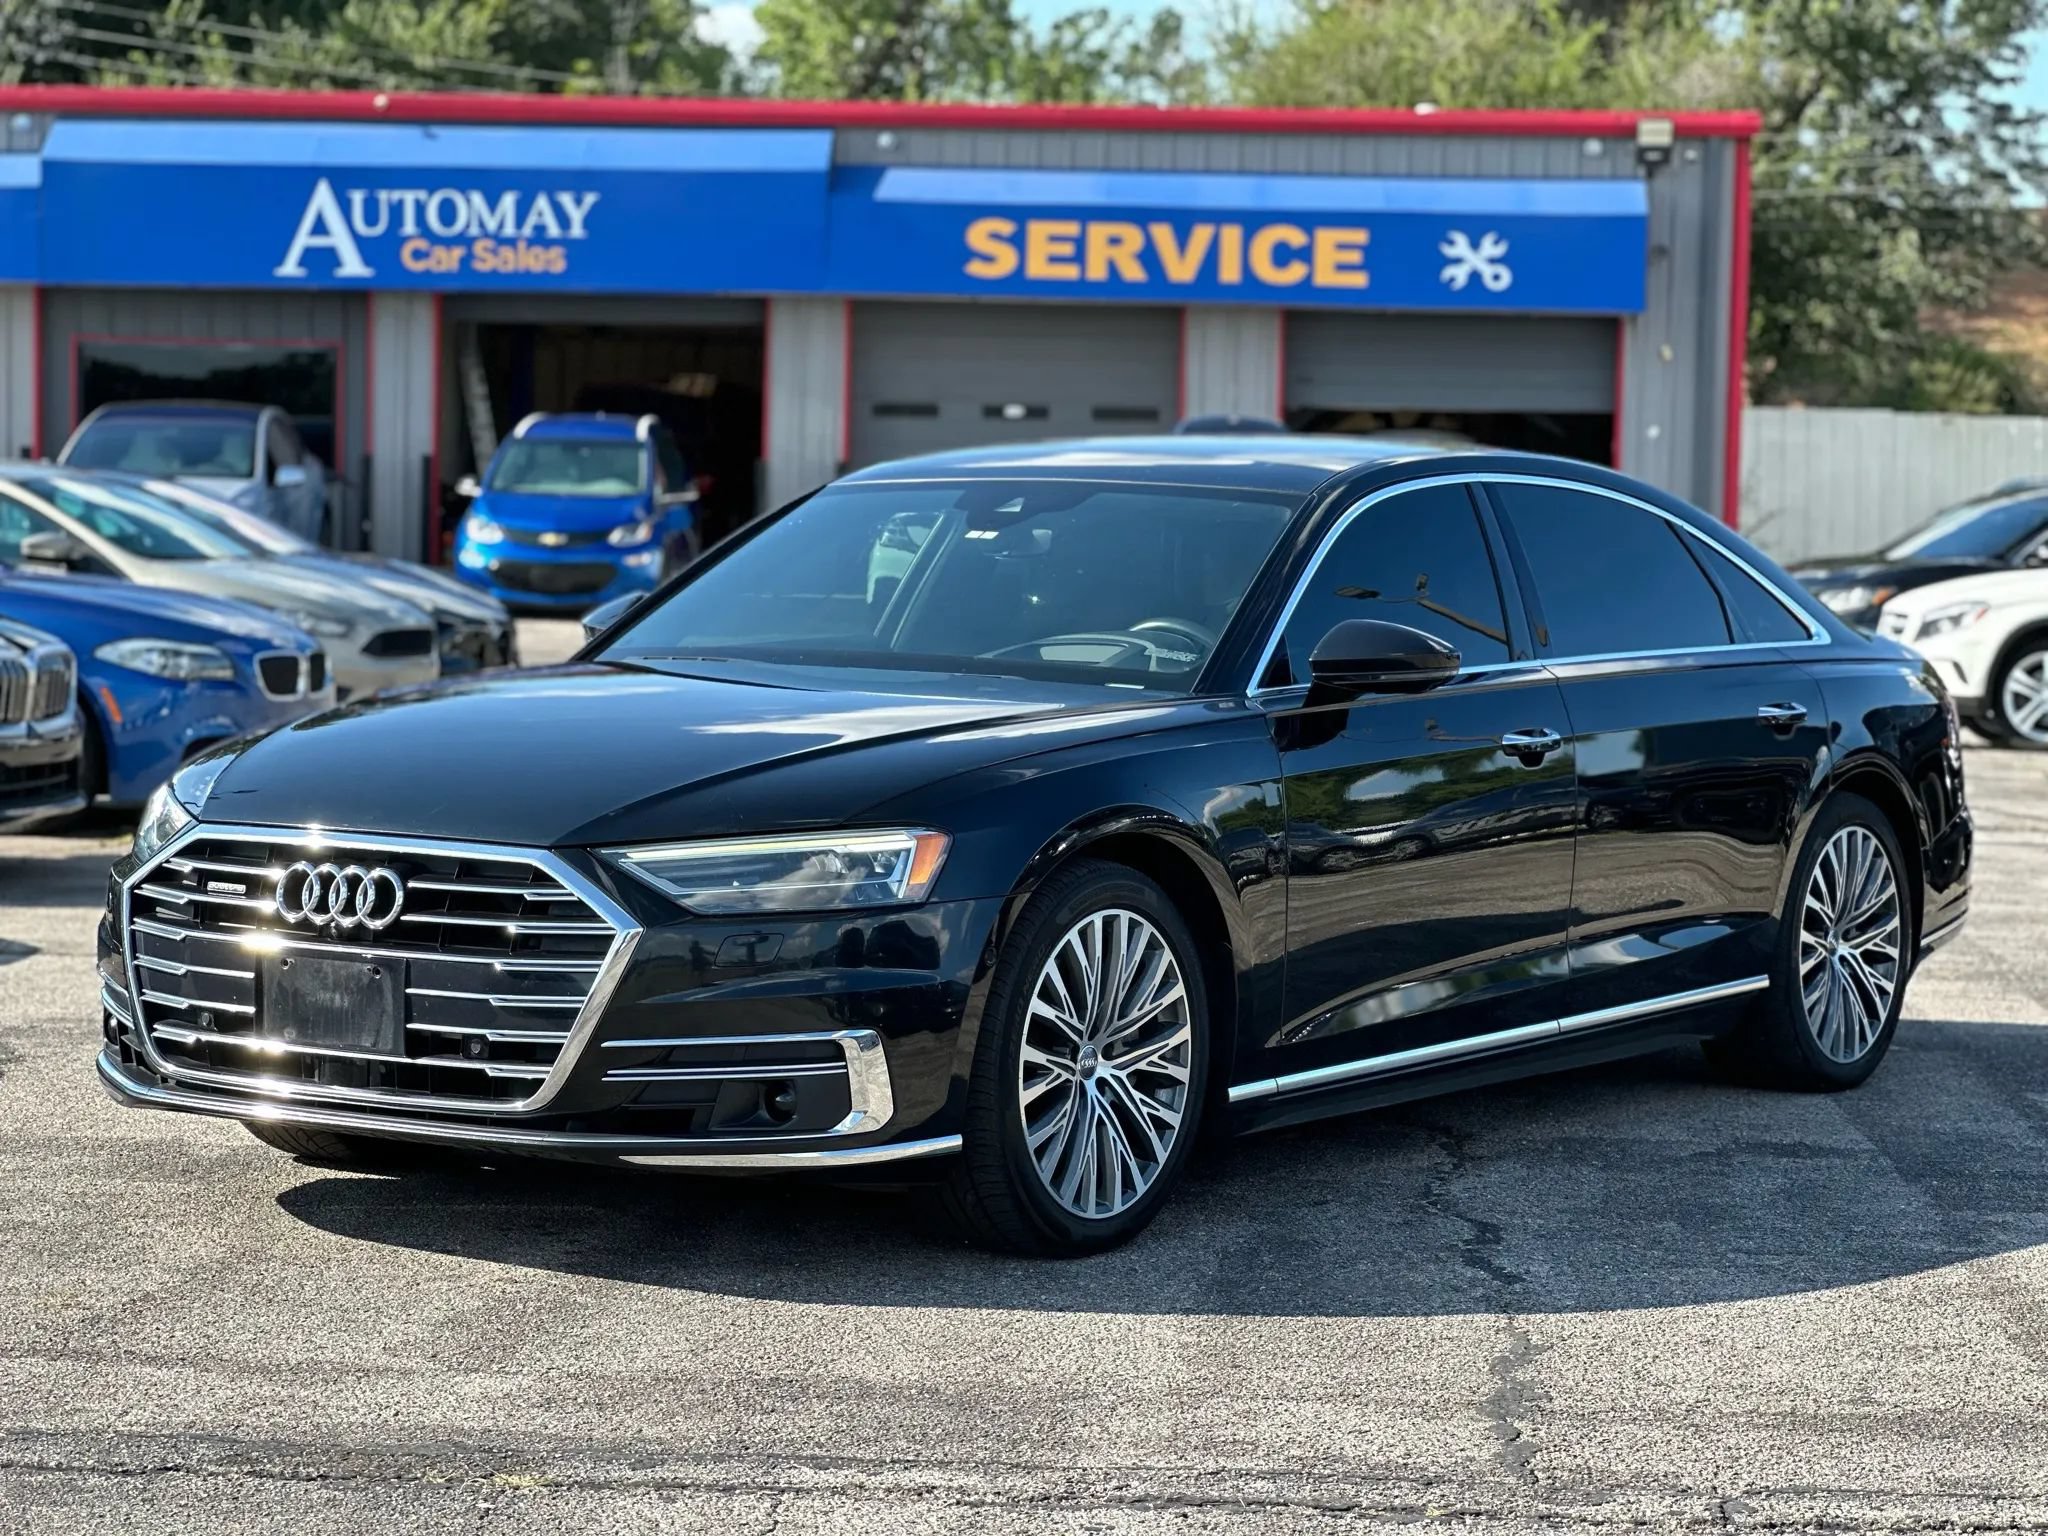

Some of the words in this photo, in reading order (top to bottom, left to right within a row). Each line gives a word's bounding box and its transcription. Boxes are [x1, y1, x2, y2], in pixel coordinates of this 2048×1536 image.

[274, 178, 598, 277] AUTOMAY
[400, 239, 466, 272] Car
[471, 240, 567, 274] Sales
[965, 217, 1369, 288] SERVICE
